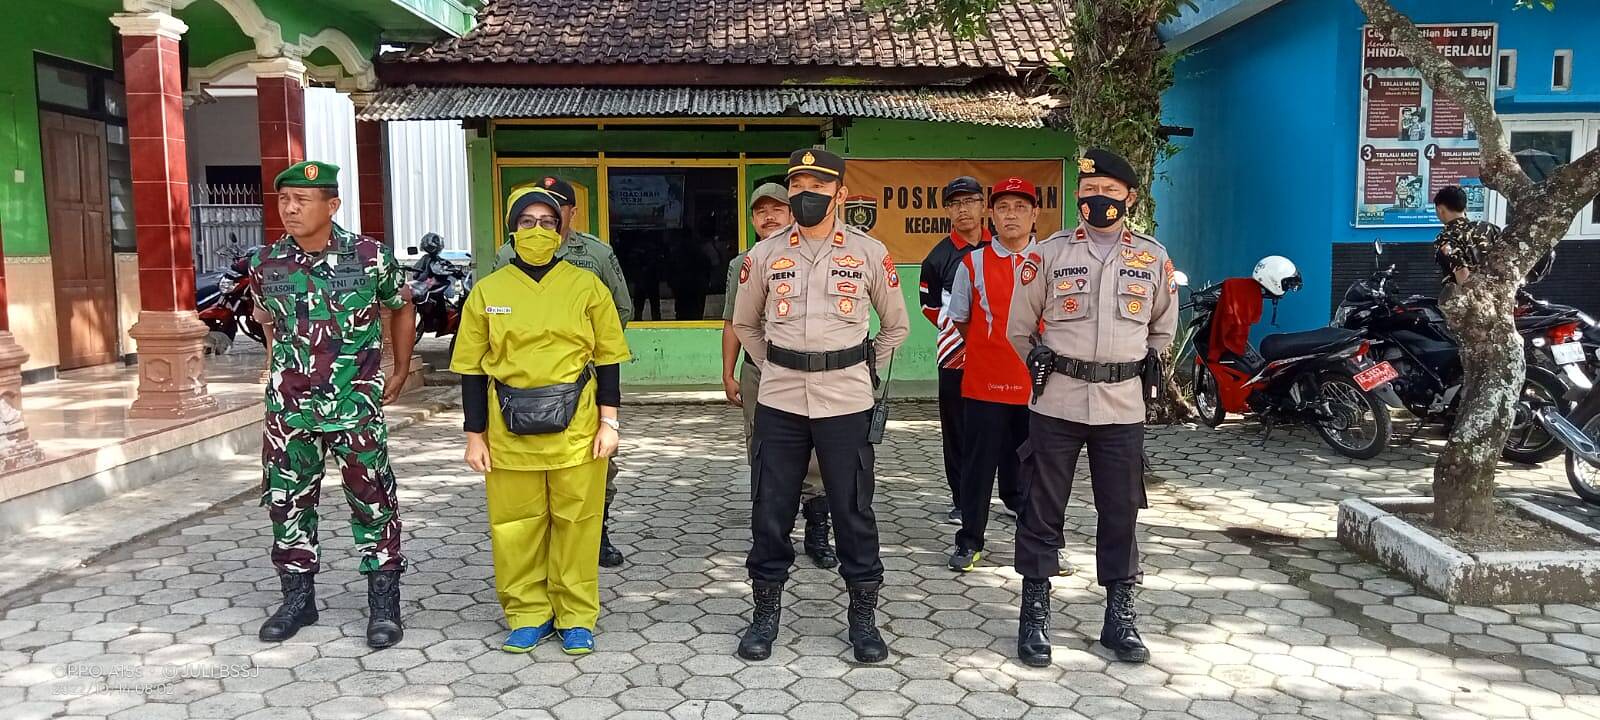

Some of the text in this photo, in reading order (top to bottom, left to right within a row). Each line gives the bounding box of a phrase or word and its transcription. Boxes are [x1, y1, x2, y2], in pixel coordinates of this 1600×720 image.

[1443, 28, 1458, 37] Ibu
[1461, 28, 1468, 36] &
[1471, 28, 1492, 39] Bayi
[1366, 45, 1491, 57] HINDA TERLALU
[1366, 75, 1373, 89] 1
[1363, 146, 1372, 160] 3
[1427, 145, 1435, 159] 4
[771, 271, 795, 281] JEEN
[831, 269, 862, 280] POLRI
[1053, 266, 1088, 279] SUTIKNO
[1119, 268, 1151, 280] POLRI
[331, 278, 366, 288] TNI AD
